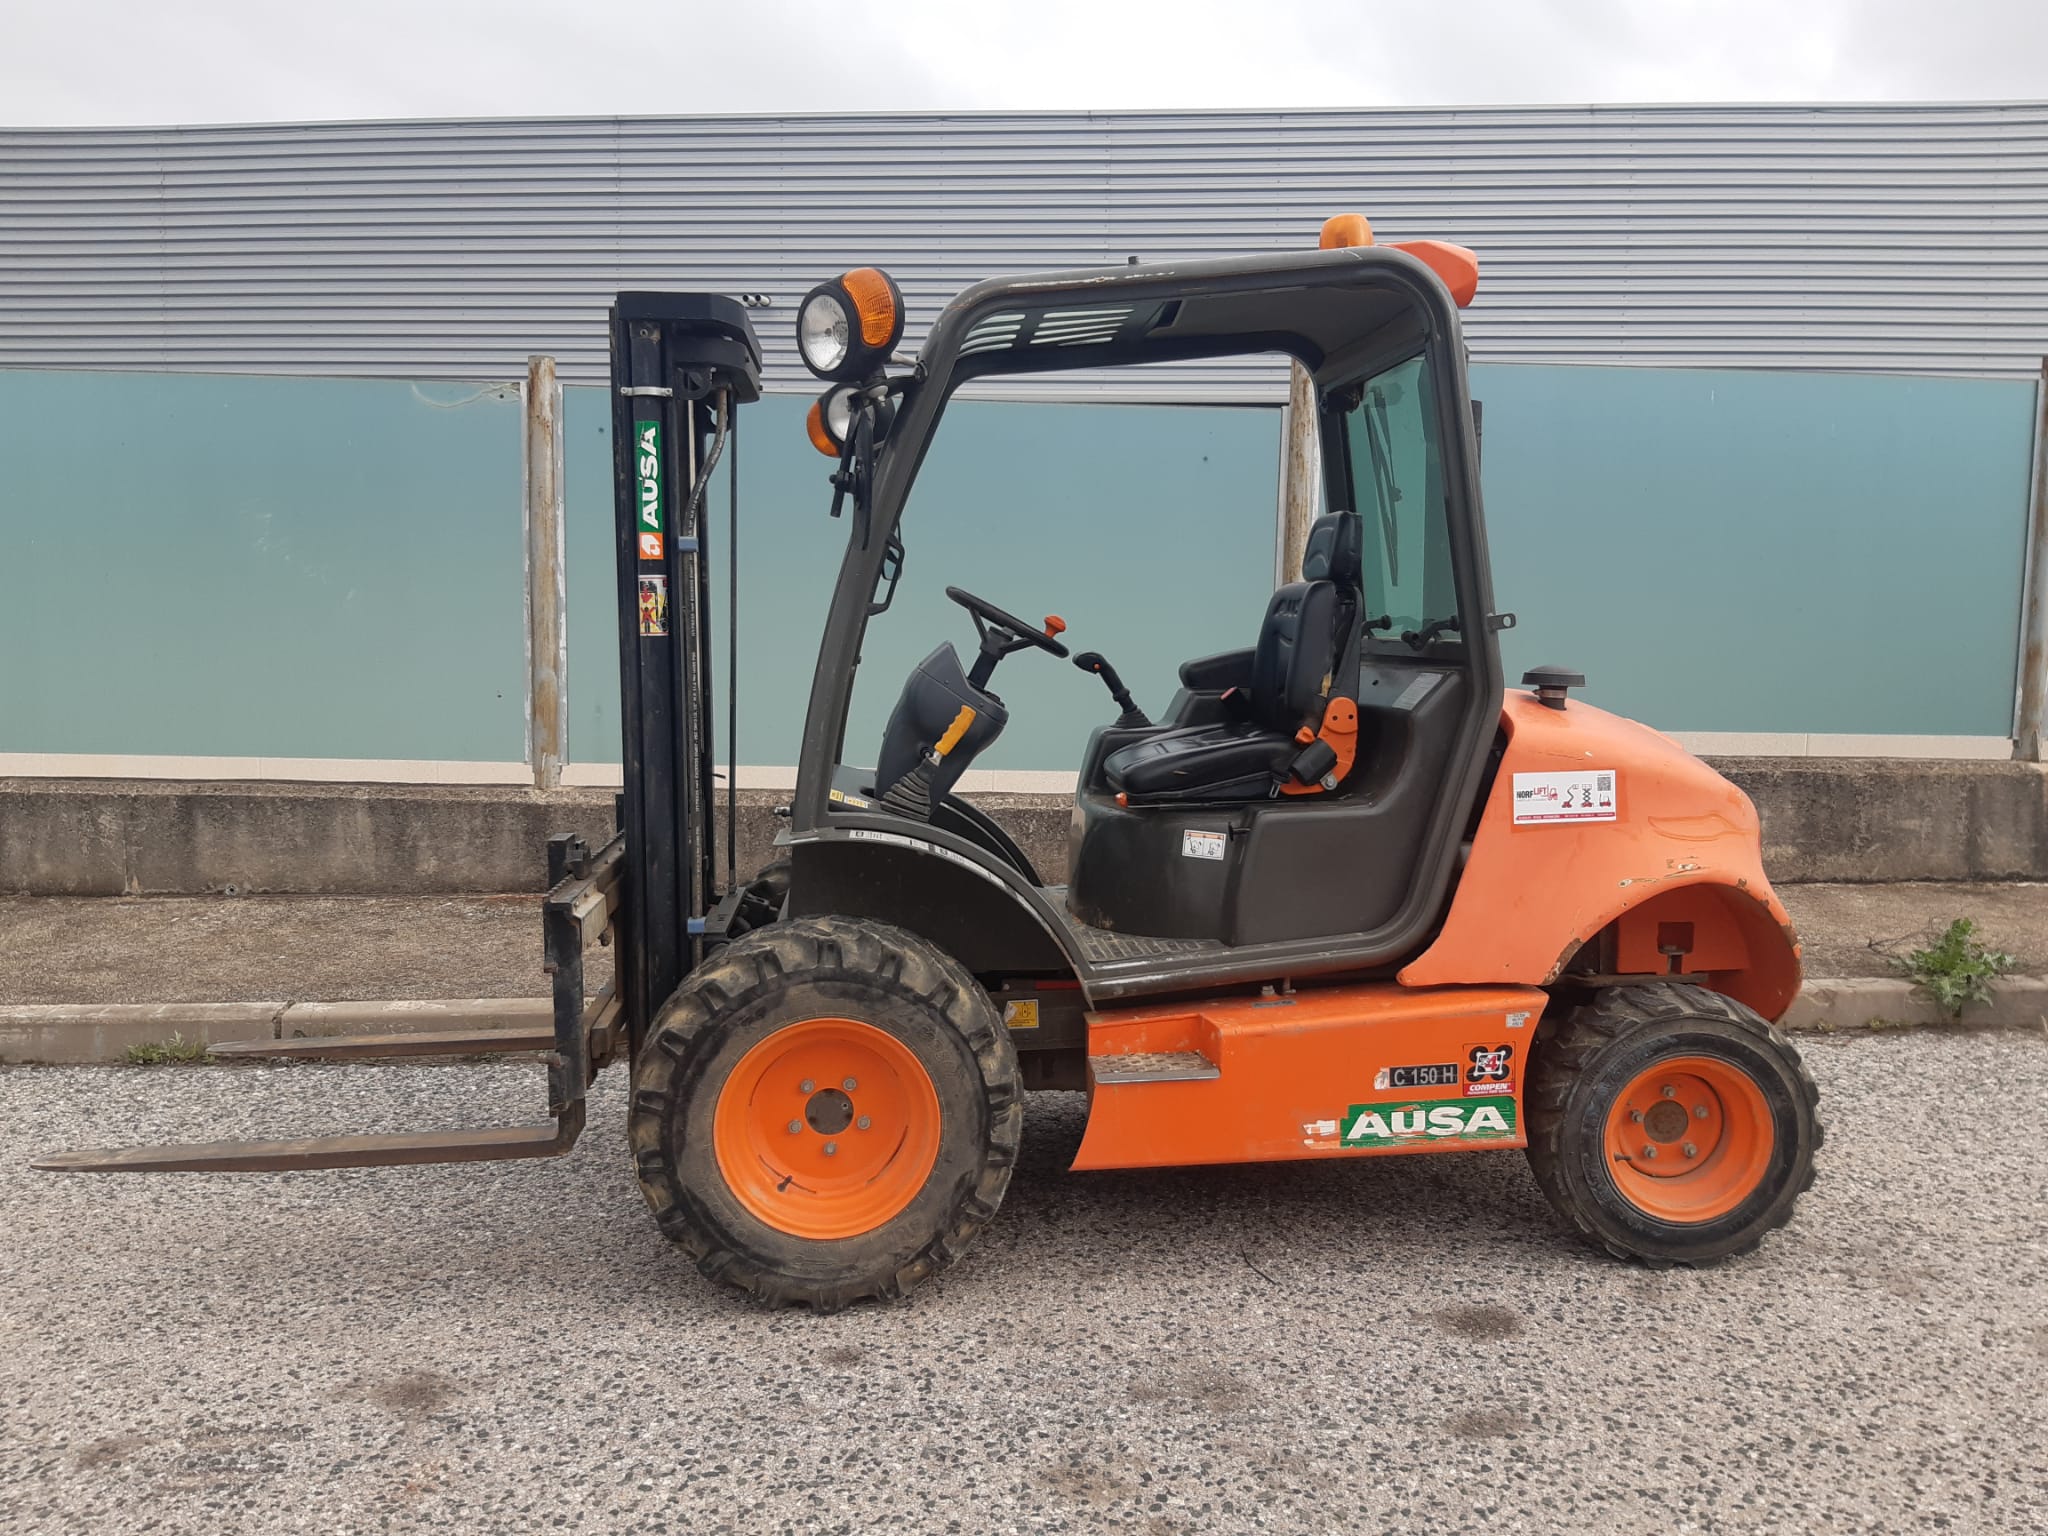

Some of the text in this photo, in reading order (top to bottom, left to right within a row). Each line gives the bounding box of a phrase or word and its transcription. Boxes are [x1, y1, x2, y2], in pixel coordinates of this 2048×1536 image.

[640, 427, 658, 529] AUSA
[1394, 1066, 1454, 1086] C 150 H
[1469, 1083, 1508, 1092] COMPEN
[1347, 1106, 1509, 1139] AUSA
